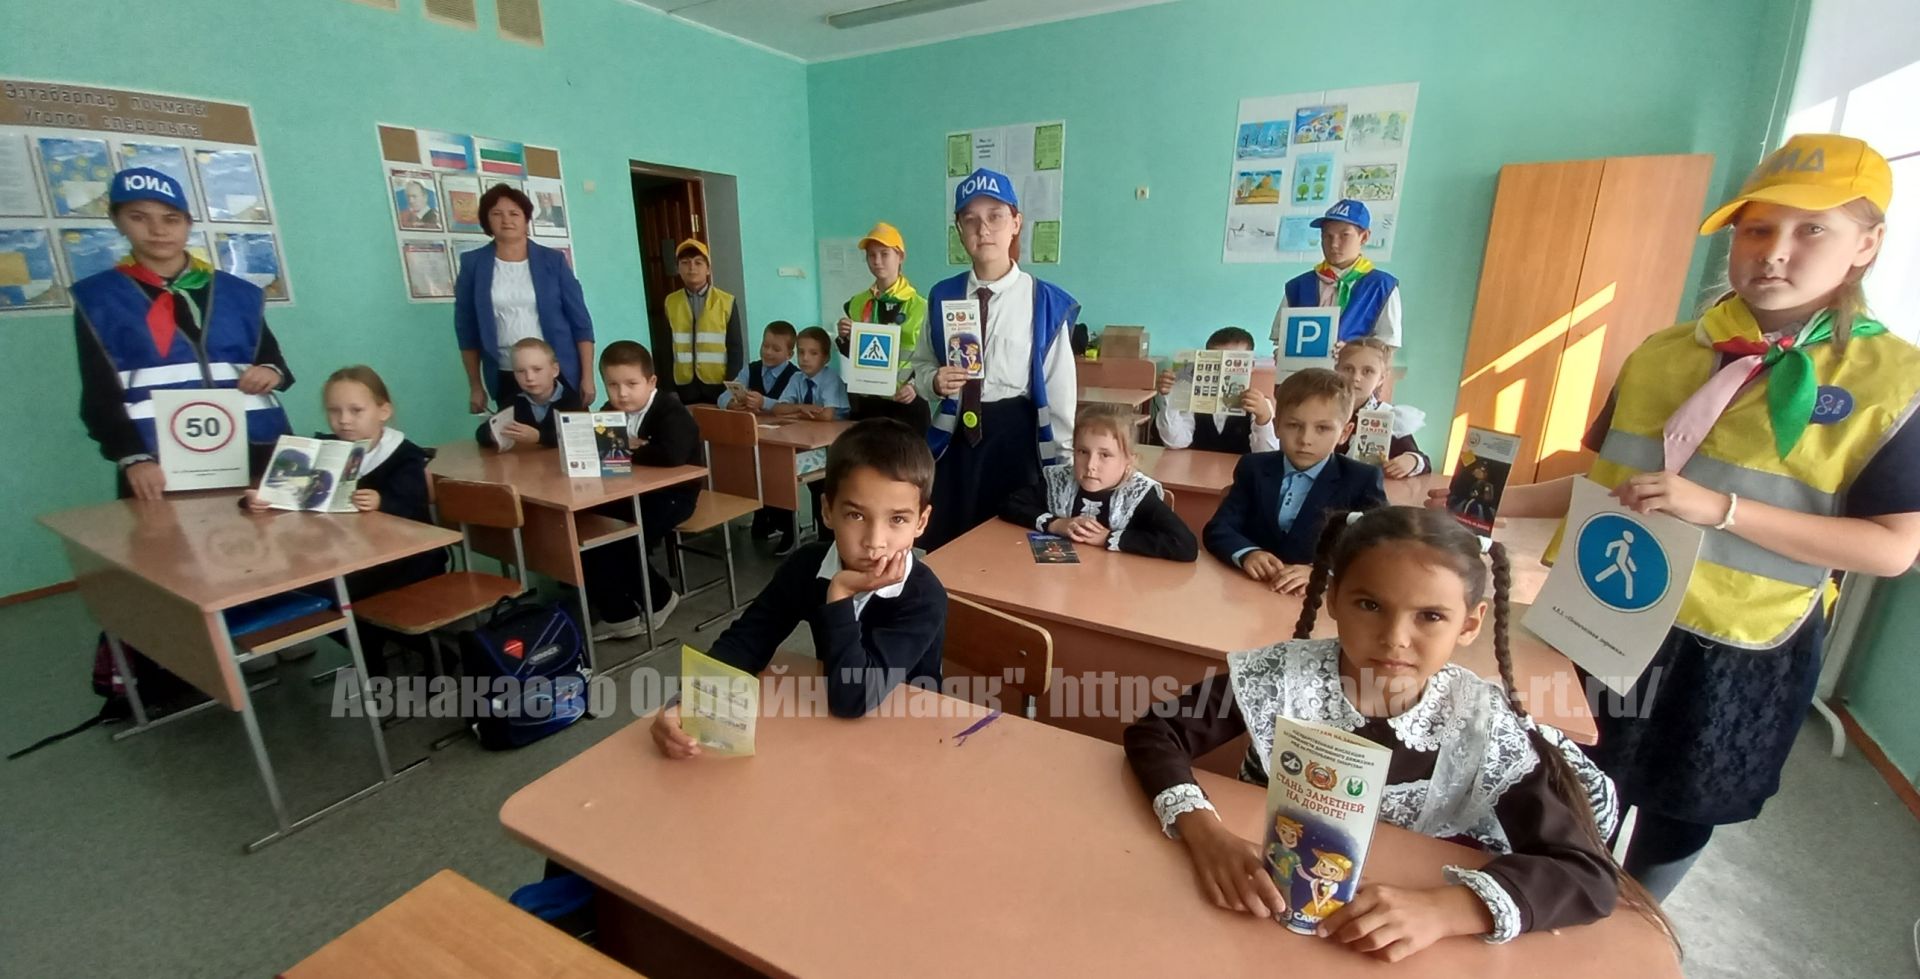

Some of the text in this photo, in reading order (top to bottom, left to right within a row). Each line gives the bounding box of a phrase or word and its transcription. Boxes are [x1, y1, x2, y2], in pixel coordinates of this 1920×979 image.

[124, 174, 176, 198] ЮИД
[961, 175, 1001, 199] ЮИД
[1295, 320, 1322, 354] P
[185, 416, 221, 438] 50
[1275, 772, 1366, 814] СТАНЬ ЗАМЕТНЕЙ
[1286, 789, 1347, 820] НА ДОРОГЕ!
